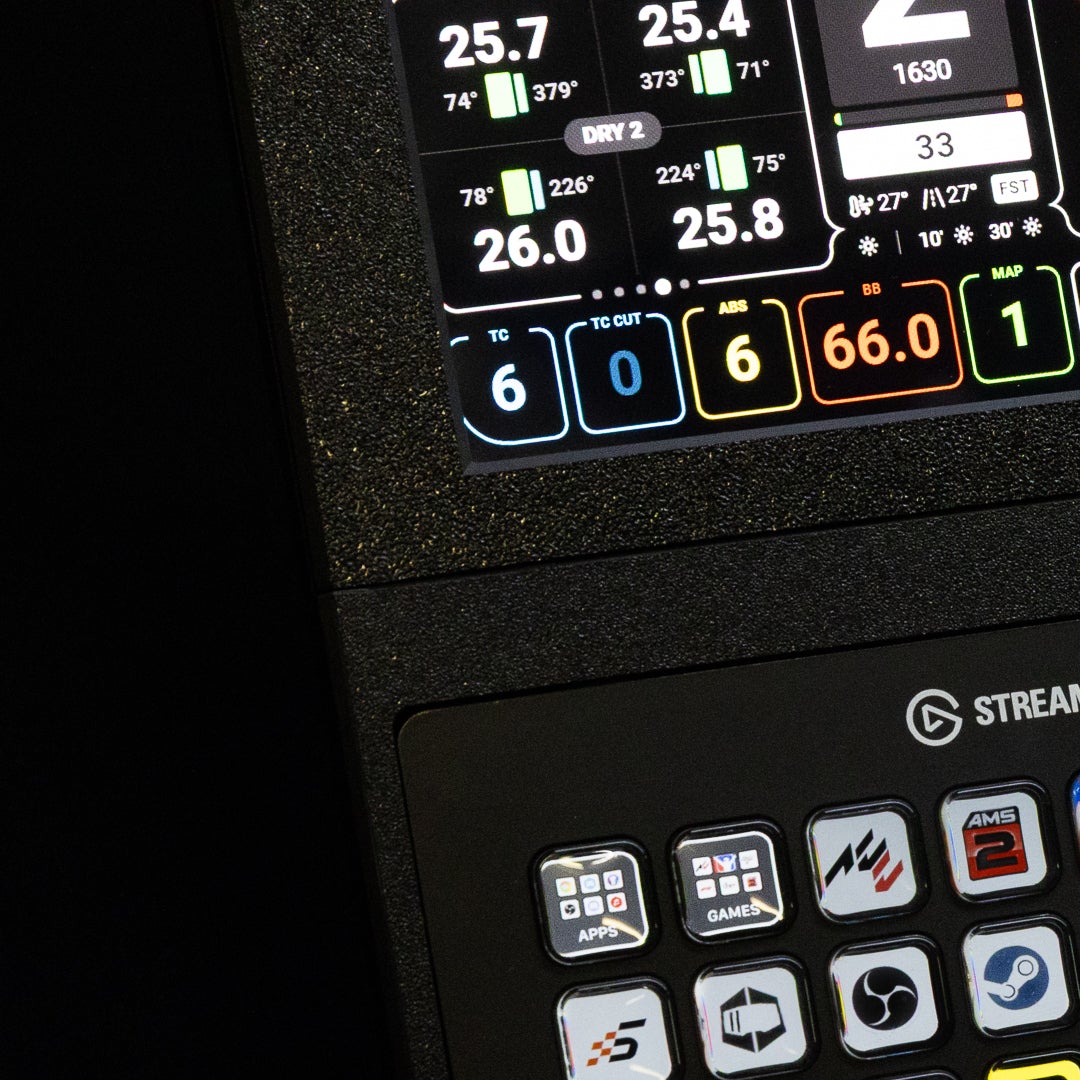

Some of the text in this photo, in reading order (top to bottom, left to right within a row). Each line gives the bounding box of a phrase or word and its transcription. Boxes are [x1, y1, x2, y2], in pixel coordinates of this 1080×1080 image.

[638, 0, 751, 48] 25.4
[438, 15, 549, 69] 25.7
[639, 68, 686, 89] 373°
[736, 59, 770, 80] 71°
[892, 58, 953, 84] 1630
[443, 91, 478, 112] 74°
[532, 80, 579, 101] 379°
[581, 120, 645, 145] DRY 2
[915, 132, 954, 160] 33
[656, 162, 702, 185] 224°
[752, 153, 786, 174] 75°
[459, 186, 494, 207] 78°
[548, 174, 595, 197] 226°
[946, 182, 978, 204] 27°
[999, 179, 1029, 195] FST
[876, 191, 909, 212] 27°
[672, 197, 784, 250] 25.8
[473, 219, 587, 273] 26.0
[991, 264, 1024, 280] MAP
[862, 282, 882, 296] BB
[718, 299, 748, 316] ABS
[590, 311, 642, 331] TC CUT
[1001, 300, 1028, 347] 1
[488, 328, 509, 342] TC
[823, 312, 940, 370] 66.0
[725, 334, 761, 382] 6
[608, 349, 643, 397] 0
[491, 363, 527, 412] 6
[966, 808, 1016, 830] AMS
[974, 831, 1016, 871] 2
[707, 904, 761, 923] GAMES
[578, 925, 619, 943] APPS
